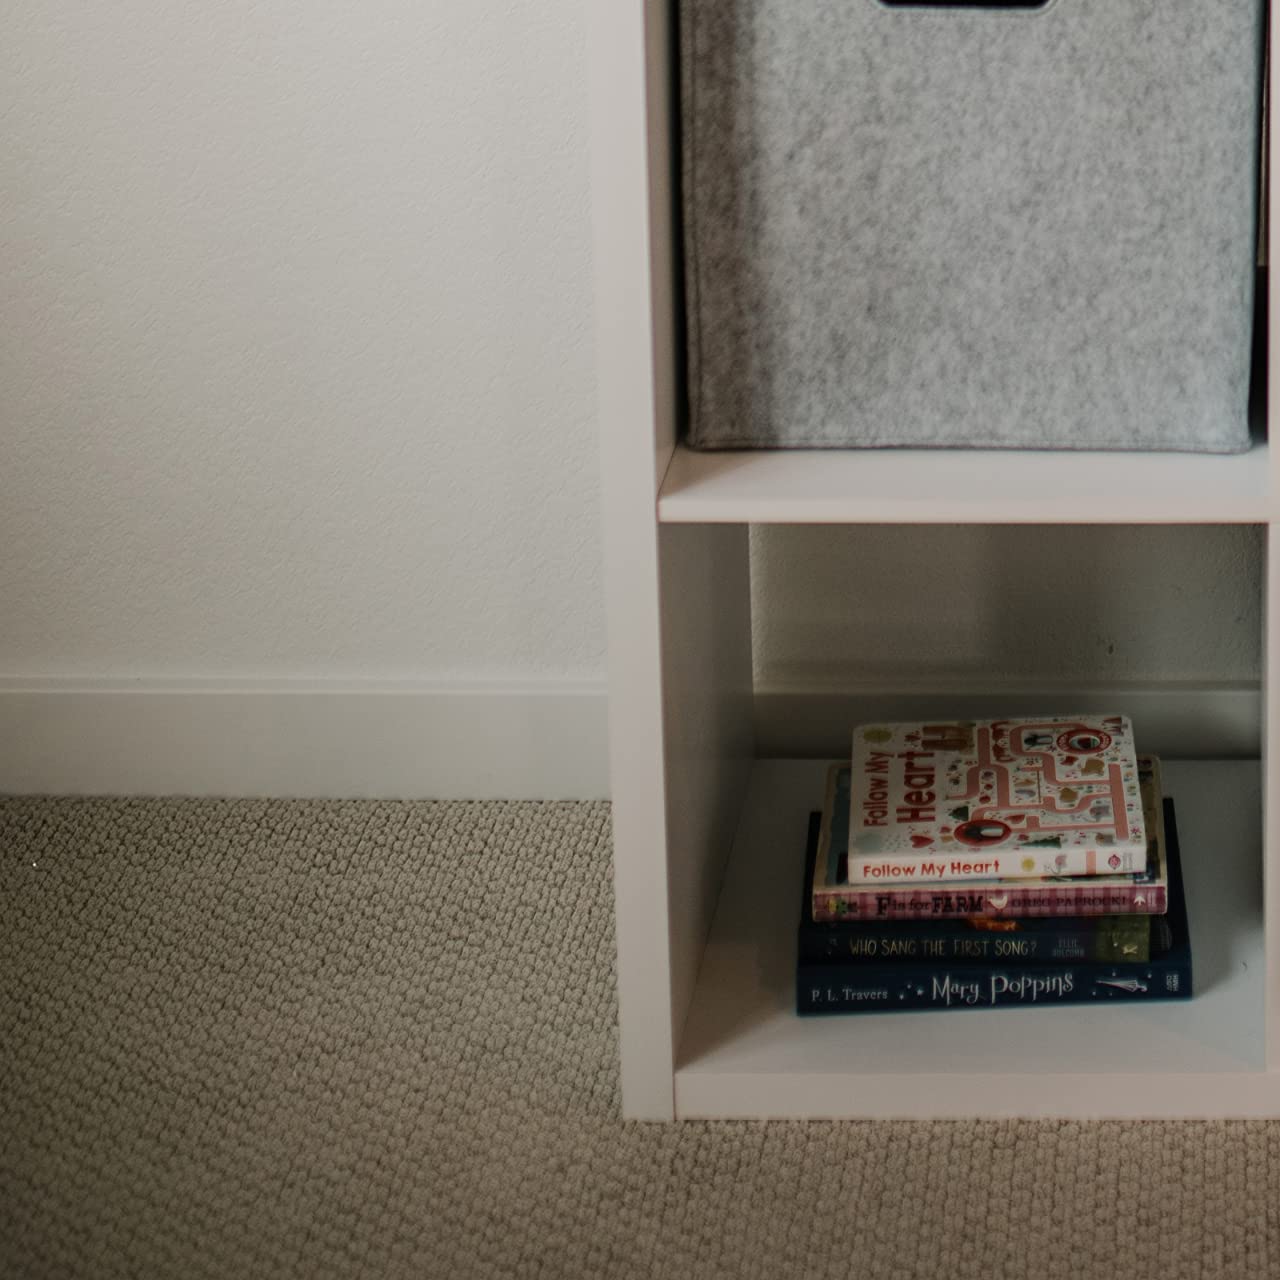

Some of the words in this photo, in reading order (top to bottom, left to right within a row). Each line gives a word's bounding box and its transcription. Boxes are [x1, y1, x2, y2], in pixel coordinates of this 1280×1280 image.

[864, 751, 894, 771] My
[896, 751, 936, 823] Heart
[863, 776, 889, 827] Follow
[863, 865, 915, 878] Follow
[920, 863, 945, 878] My
[951, 860, 1000, 875] Heart
[876, 896, 890, 915] F
[892, 901, 906, 911] is
[908, 899, 931, 911] for
[932, 896, 983, 913] FARM
[849, 938, 877, 956] WHO
[881, 937, 916, 956] SANG
[922, 937, 945, 956] THE
[954, 937, 989, 956] FIRST
[995, 937, 1038, 957] SONG?
[842, 988, 889, 1001] Travers
[932, 975, 980, 1006] Mary
[991, 973, 1073, 1005] Poppins
